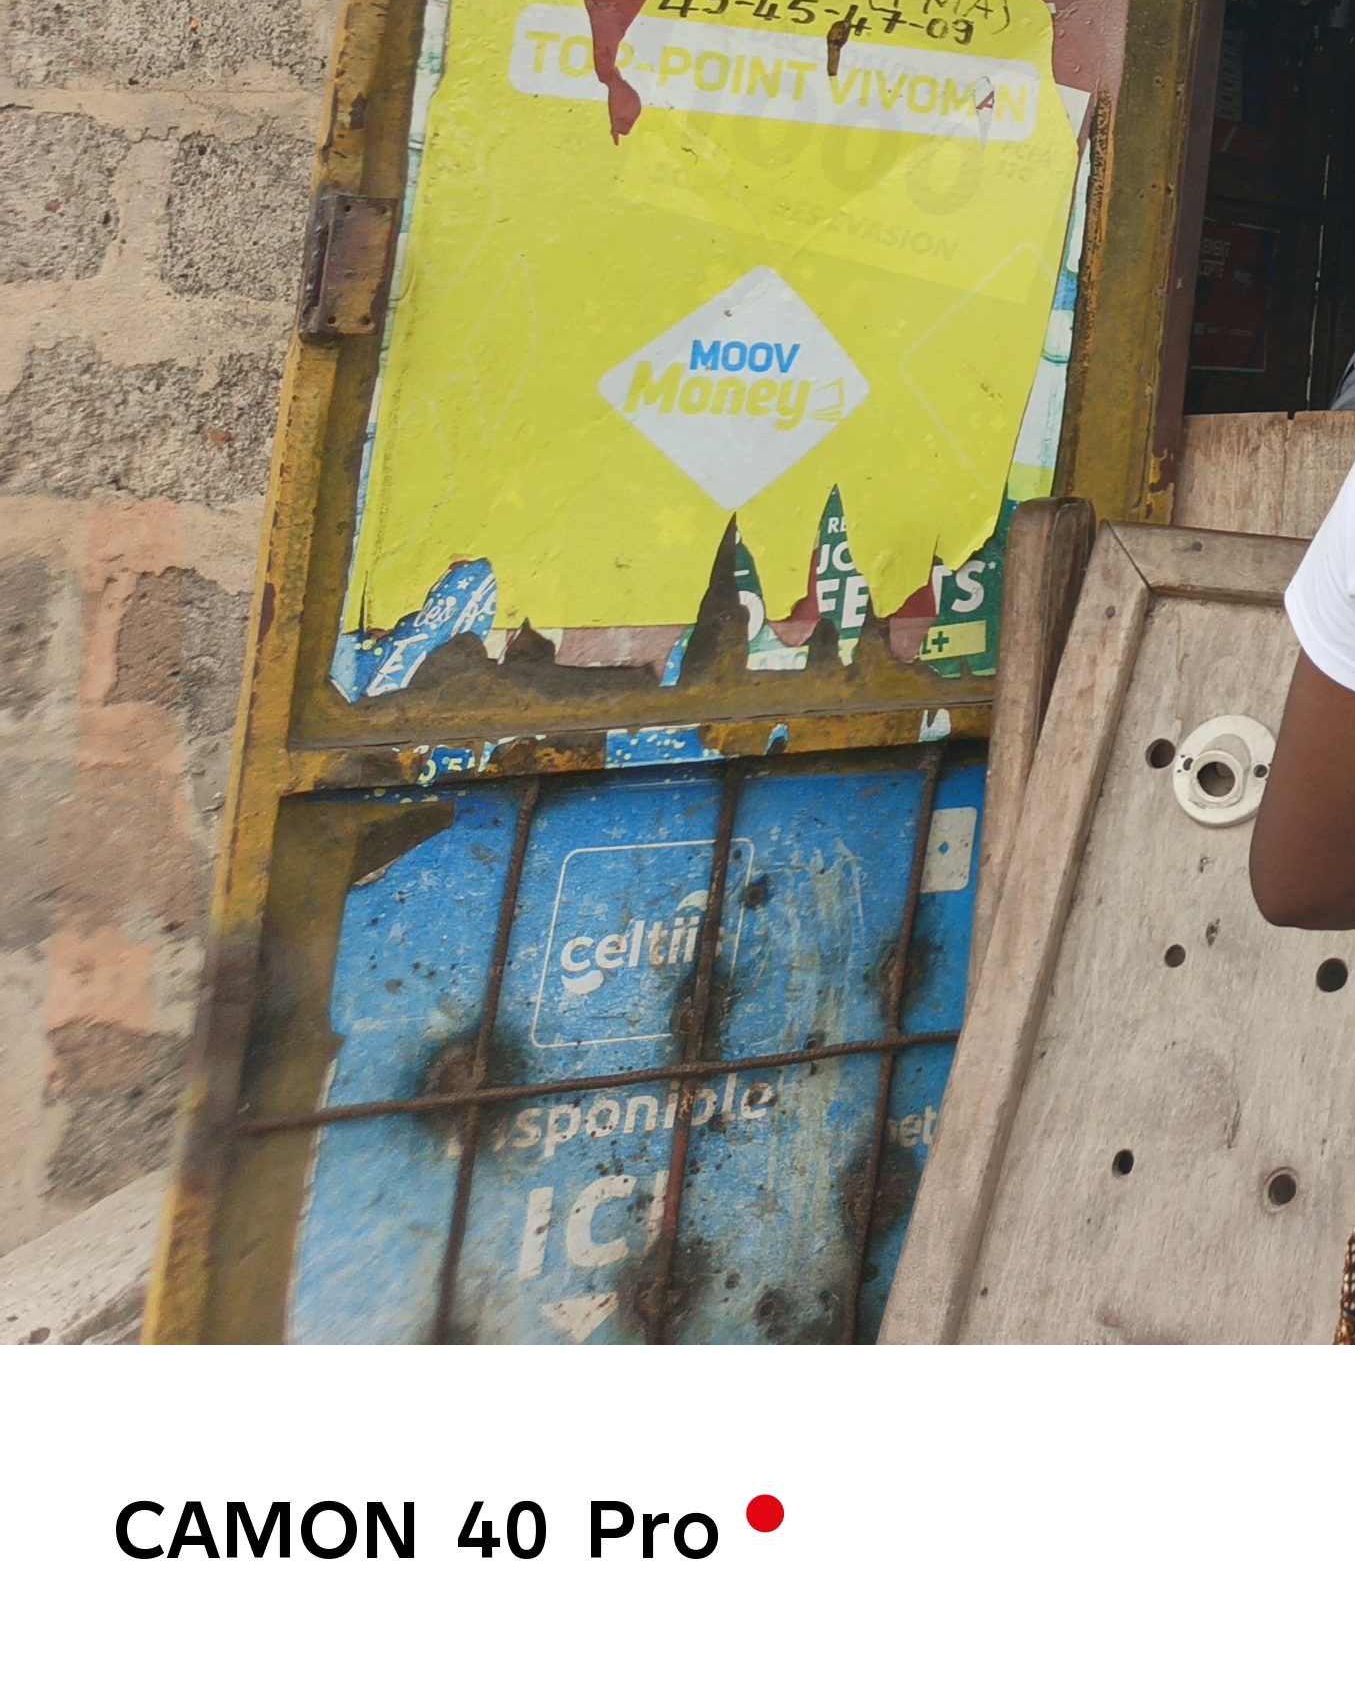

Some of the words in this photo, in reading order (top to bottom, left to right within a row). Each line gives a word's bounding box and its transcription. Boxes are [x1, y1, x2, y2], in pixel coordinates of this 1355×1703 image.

[829, 68, 1028, 123] VIVOMN
[690, 339, 801, 373] MOOV
[623, 360, 812, 431] Money
[560, 916, 726, 970] celtii
